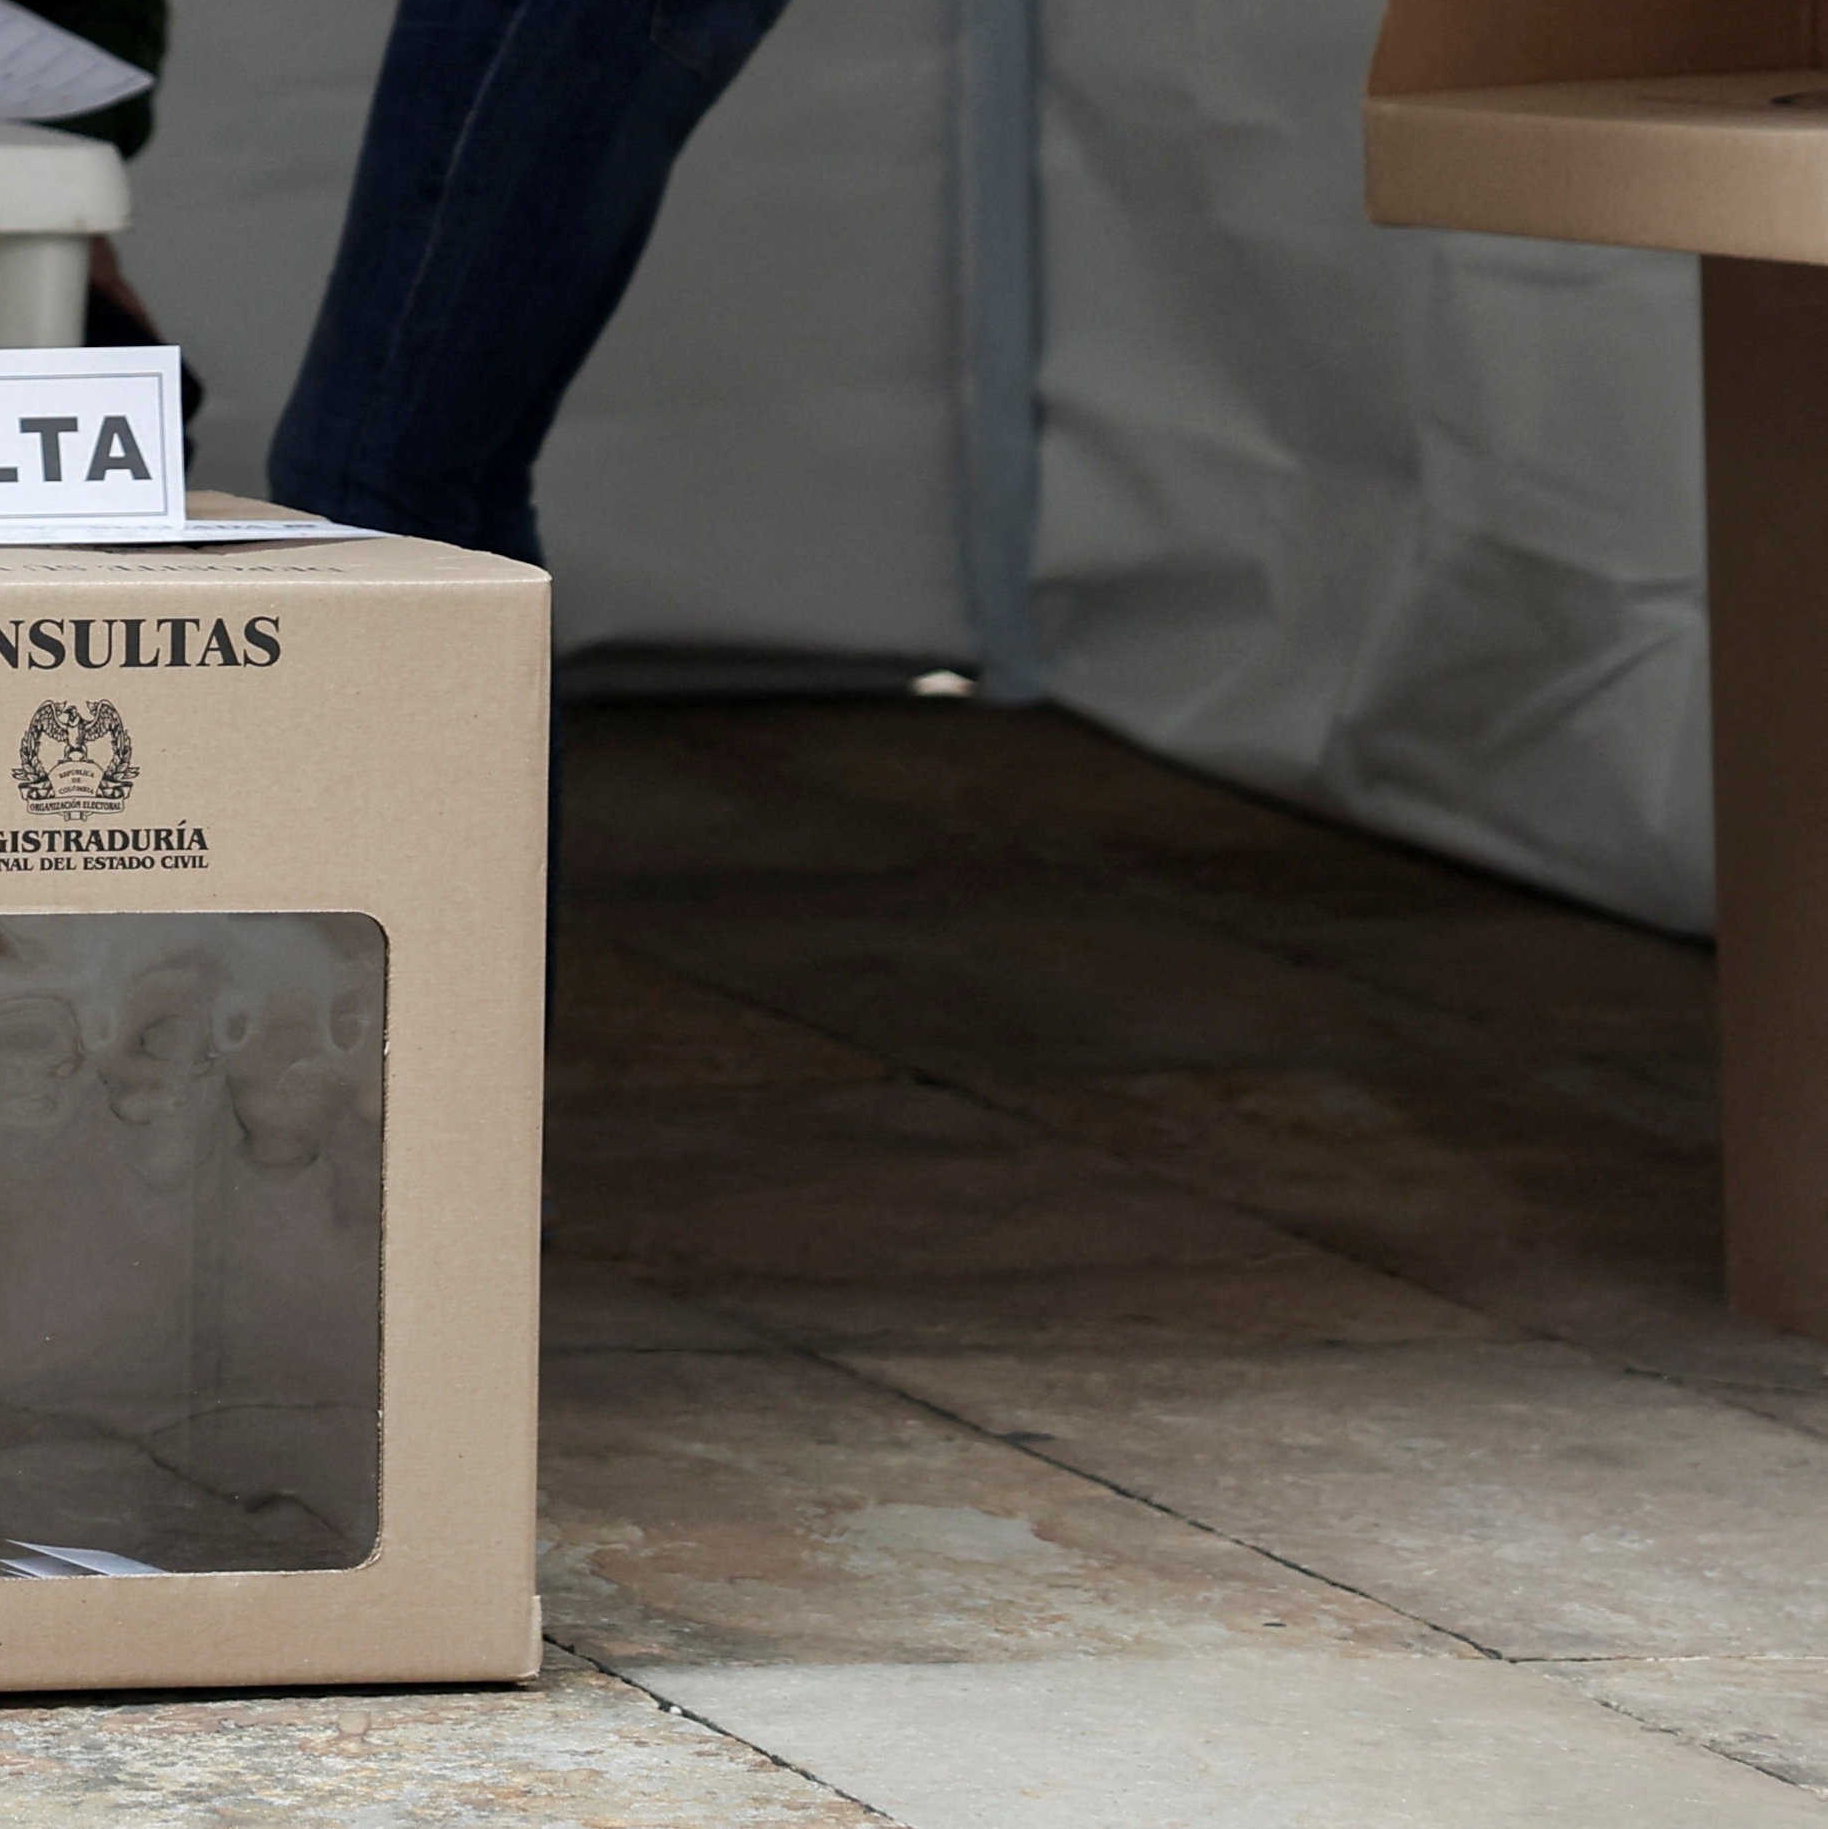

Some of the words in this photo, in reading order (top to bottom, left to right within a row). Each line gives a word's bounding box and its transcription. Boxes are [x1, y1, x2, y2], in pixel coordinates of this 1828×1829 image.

[30, 798, 81, 811] ORGANIZACIÓN
[83, 801, 121, 811] ELECTORAL
[40, 857, 77, 872] DEL
[83, 856, 155, 871] ESTADO
[160, 855, 209, 869] CIVIL
